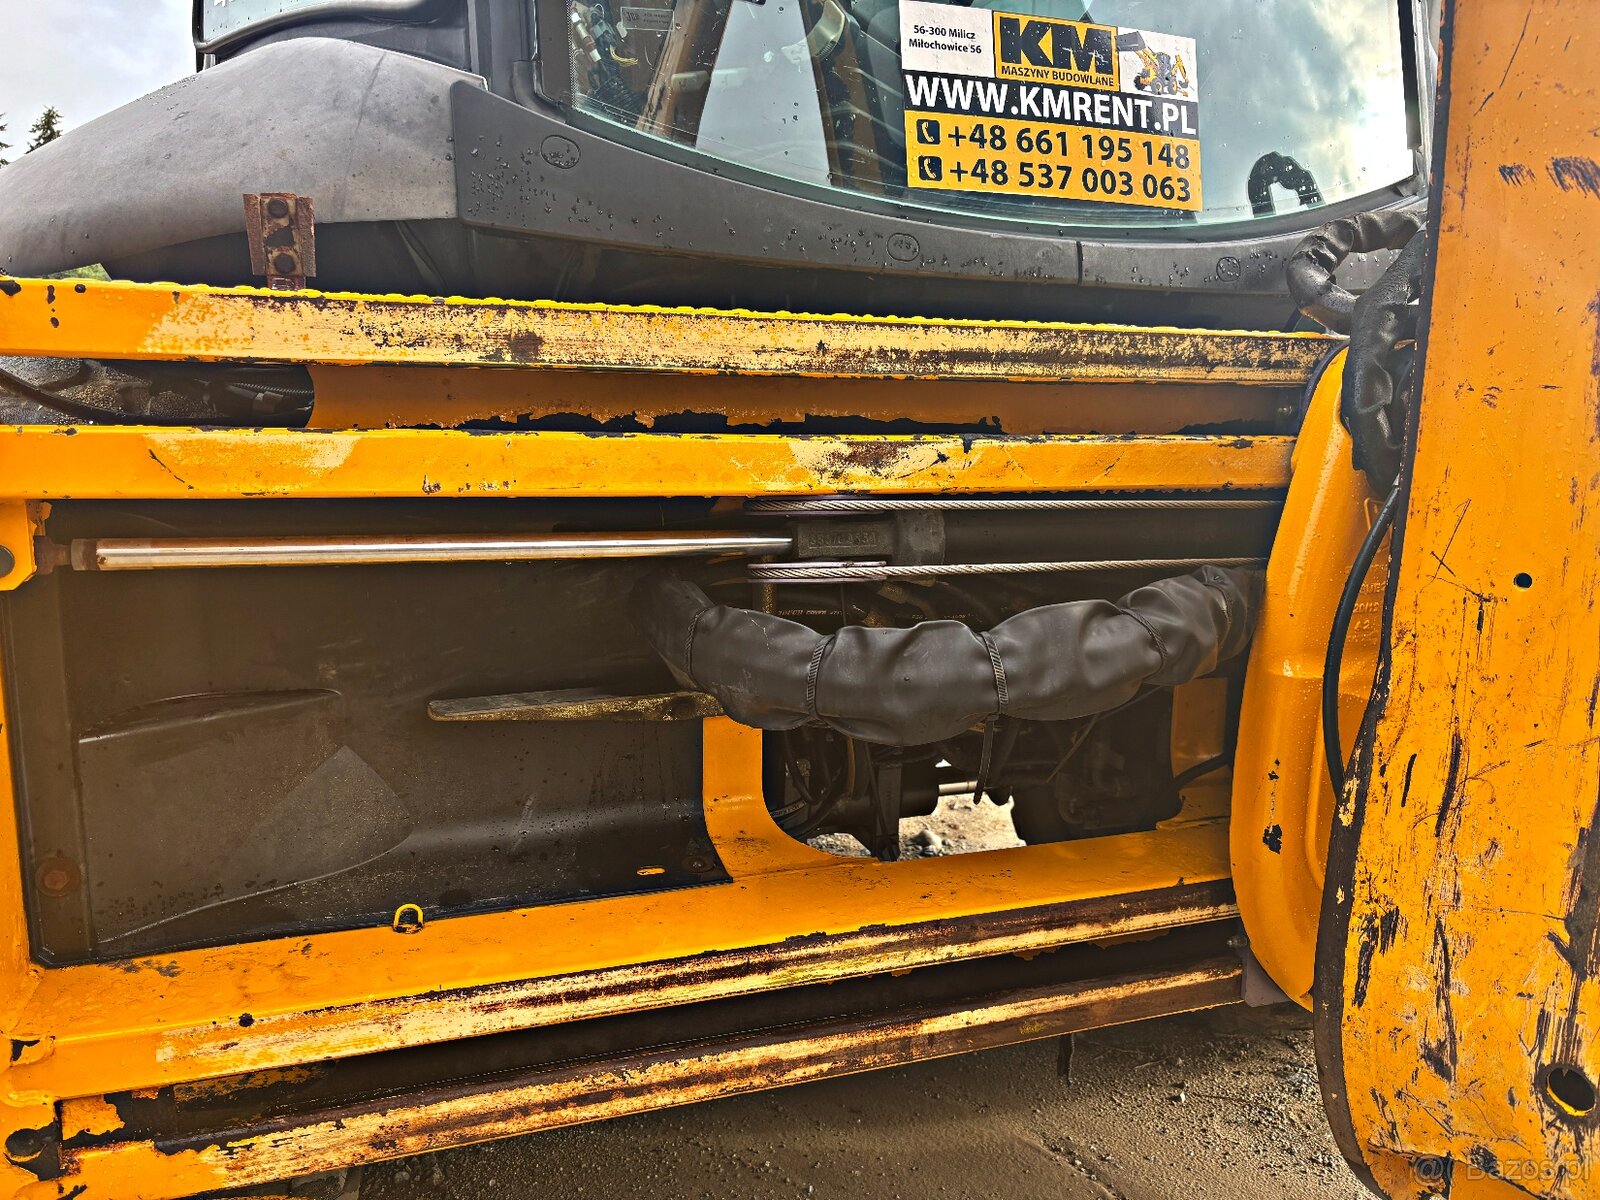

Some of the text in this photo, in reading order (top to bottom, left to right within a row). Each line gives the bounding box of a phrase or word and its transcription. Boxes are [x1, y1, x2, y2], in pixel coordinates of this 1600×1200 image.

[908, 37, 982, 54] Miłochowice 56
[913, 24, 976, 40] 56-300 Milicz
[1000, 16, 1114, 75] KM
[1001, 65, 1114, 87] MASZYNY BUDOWLANE
[904, 74, 1197, 135] WWW.KMRENT.PL
[948, 124, 1190, 170] +48 661 195 148
[950, 158, 1191, 202] +48 537 003 063
